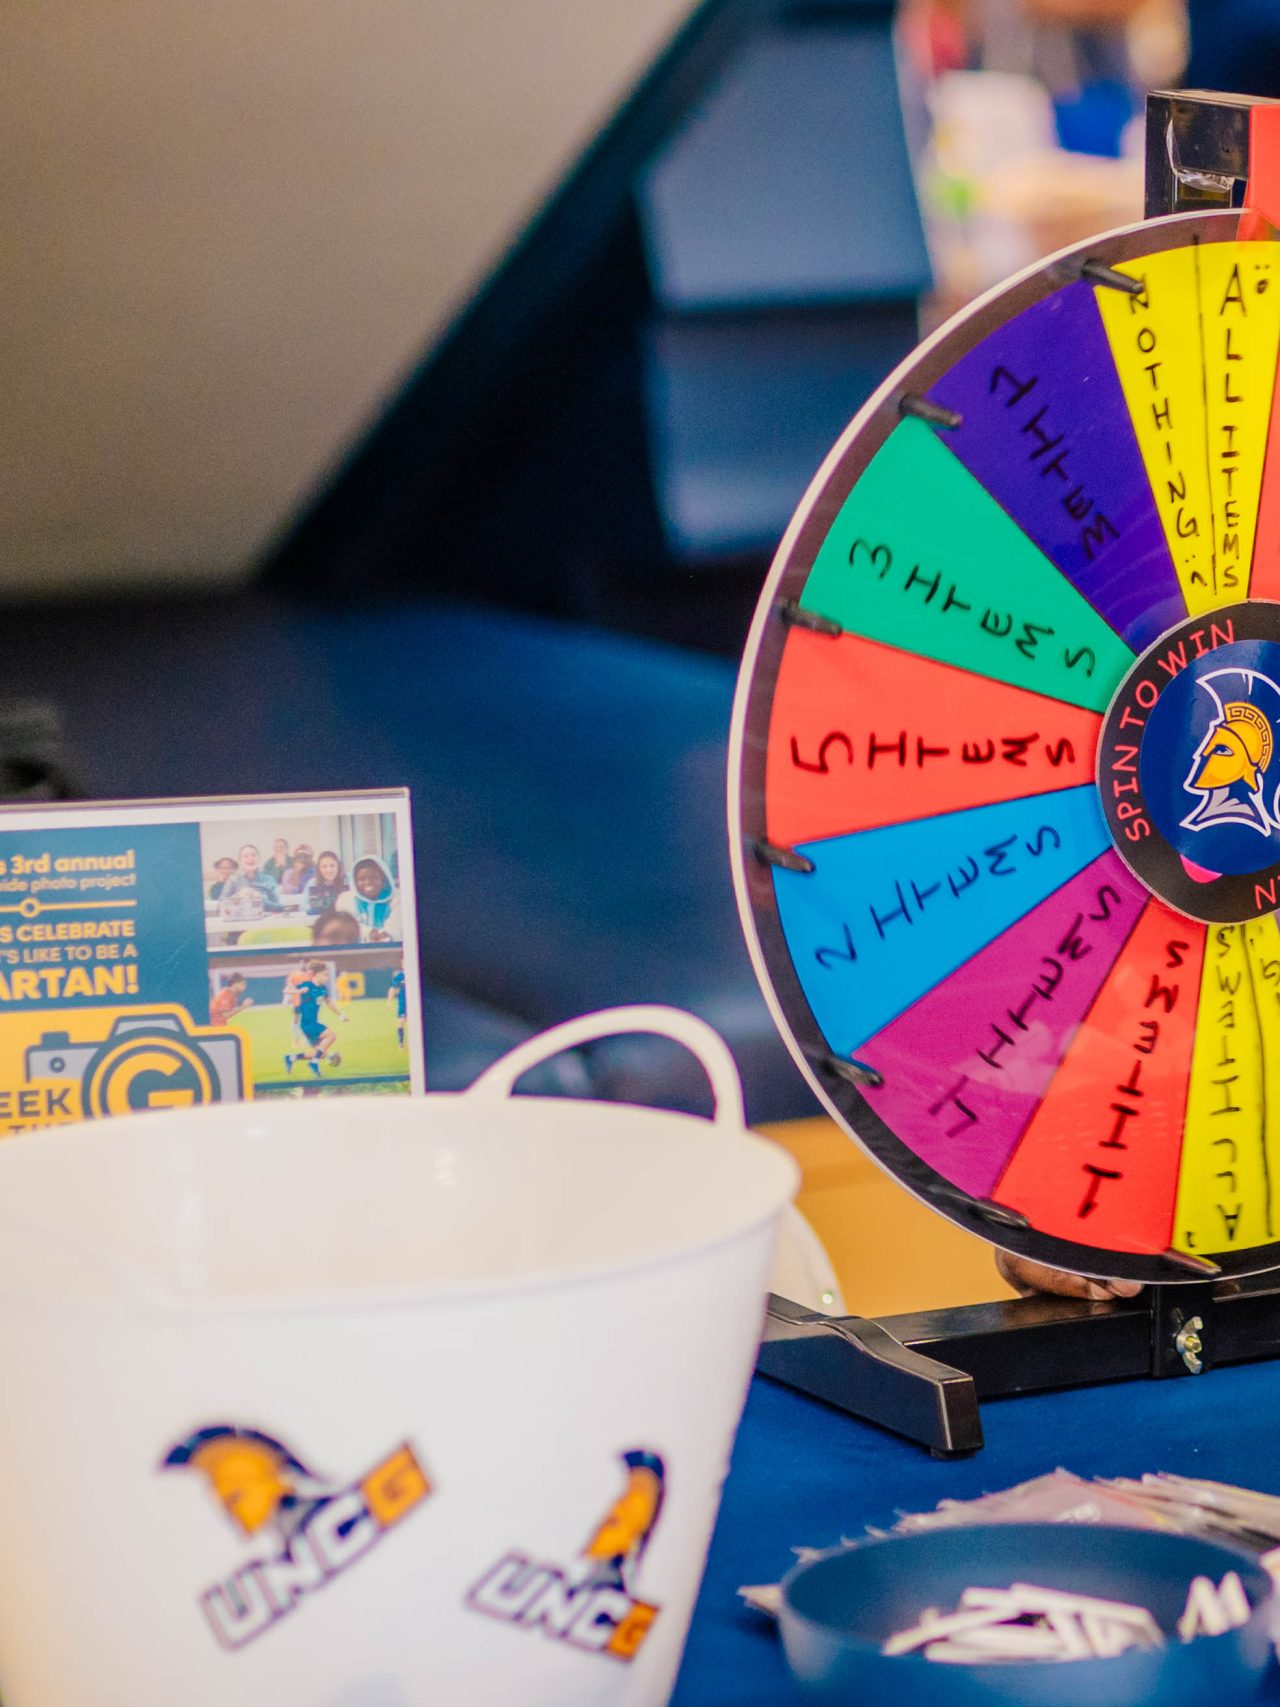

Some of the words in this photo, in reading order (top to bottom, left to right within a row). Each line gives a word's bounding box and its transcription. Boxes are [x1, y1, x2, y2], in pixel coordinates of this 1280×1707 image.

[989, 365, 1040, 410] 1
[1020, 404, 1121, 562] ITEM
[849, 537, 894, 581] 3
[903, 563, 1097, 679] ITEMS
[1156, 618, 1235, 678] WIN
[1119, 679, 1160, 730] TO
[790, 731, 854, 775] 5
[867, 730, 1075, 771] ITEMS
[1111, 743, 1151, 842] SPIN
[11, 853, 50, 875] 3rd
[54, 849, 136, 873] annual
[30, 876, 78, 893] photo
[79, 873, 136, 891] project
[814, 923, 858, 970] 2
[869, 825, 1061, 940] ITEMS
[16, 919, 136, 942] CELEBRATE
[23, 946, 62, 964] LIKE
[64, 945, 92, 961] TO
[95, 943, 120, 960] BE
[123, 943, 138, 958] A
[976, 884, 1121, 1070] ITEMS
[1099, 940, 1190, 1150] ITEMS
